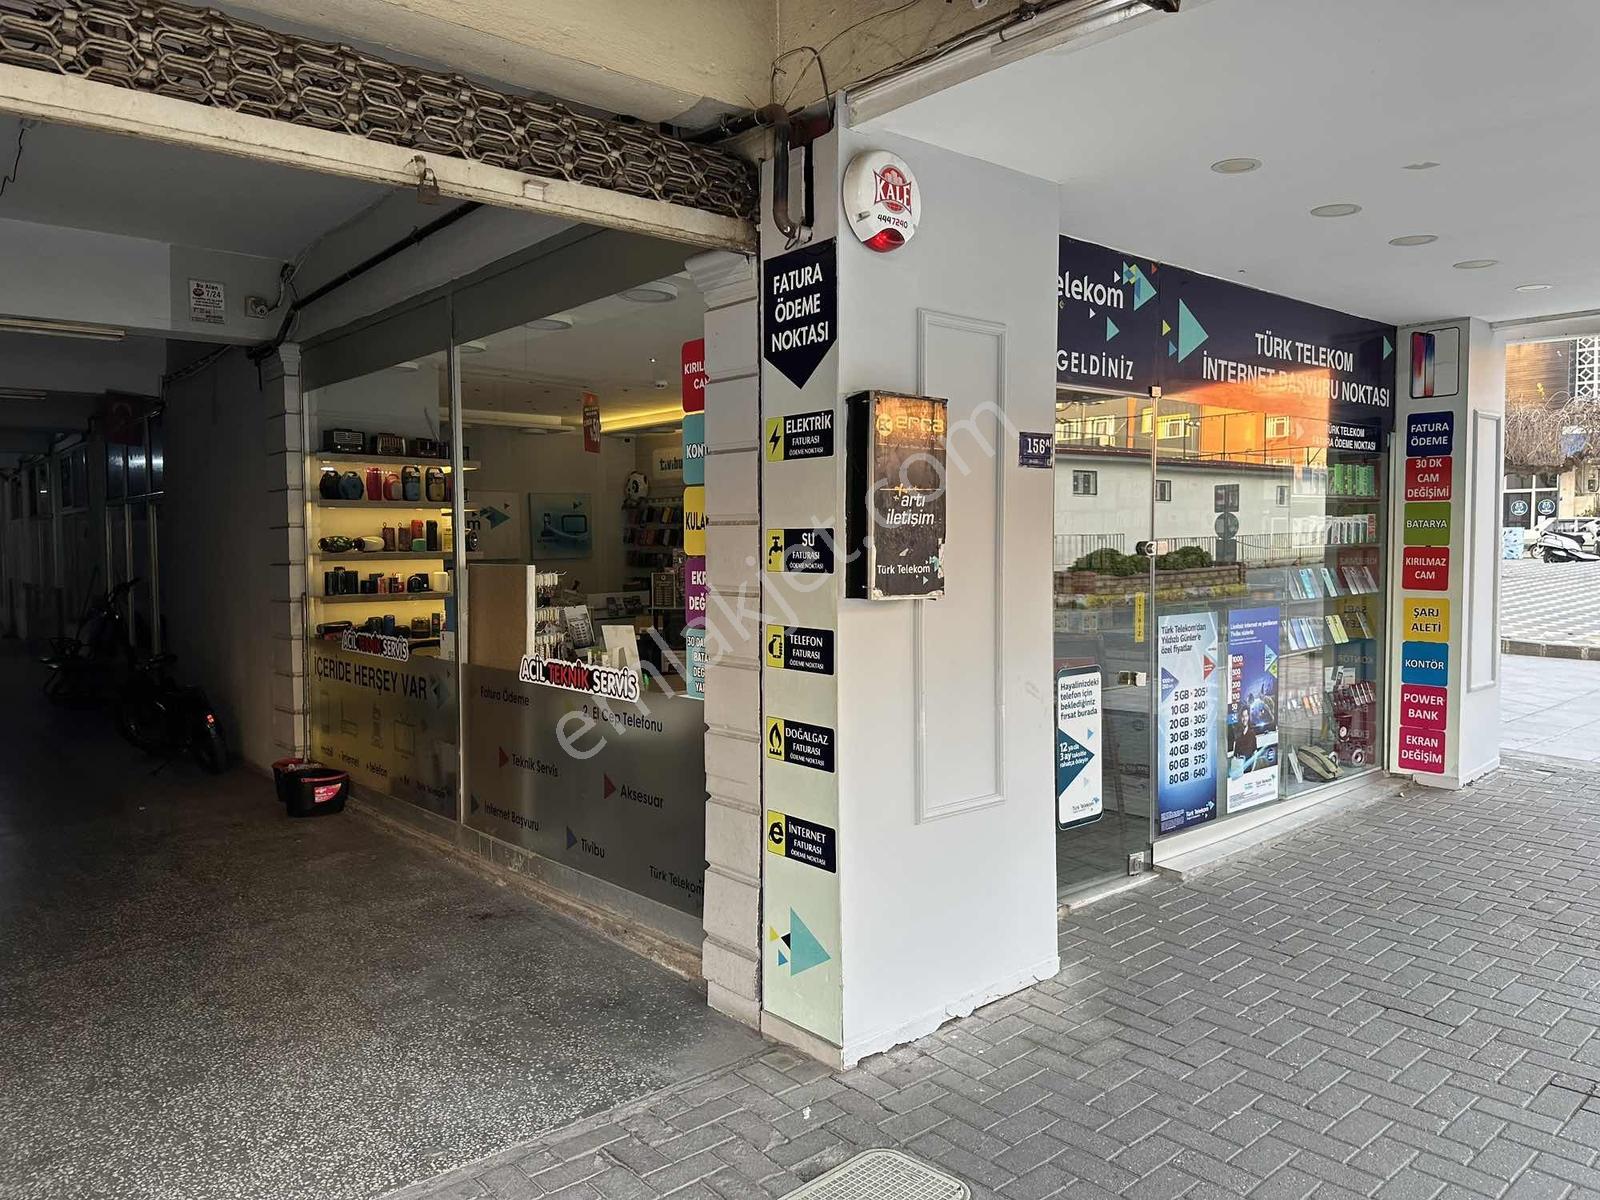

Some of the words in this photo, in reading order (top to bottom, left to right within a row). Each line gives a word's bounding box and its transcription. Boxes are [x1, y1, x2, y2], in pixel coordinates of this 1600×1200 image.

[875, 176, 911, 207] KALE
[877, 213, 908, 229] 4447240
[773, 263, 823, 295] FATURA
[774, 293, 821, 323] ÖDEME
[772, 321, 829, 352] NOKTASI
[1254, 330, 1292, 361] TÜRK
[1296, 341, 1354, 373] TELEKOM
[1056, 349, 1134, 381] GELDİNİZ
[1202, 350, 1276, 389] İNTERNET
[1341, 382, 1390, 408] NOKTASI
[786, 412, 832, 434] ELEKTRİK
[1410, 422, 1449, 434] FATURA
[1340, 425, 1365, 438] TELEKOM
[792, 435, 820, 447] FATURASI
[1334, 436, 1354, 448] ÖDEME
[1354, 440, 1377, 451] NOKTASI
[1410, 434, 1449, 447] ÖDEME
[1415, 459, 1428, 469] 30
[1429, 458, 1442, 468] DK
[1417, 473, 1440, 483] CAM
[1407, 485, 1449, 499] DEĞİŞİMİ
[901, 493, 926, 507] artı
[886, 508, 935, 527] iletişim
[1406, 520, 1447, 529] BATARYA
[801, 532, 815, 546] SU
[792, 551, 820, 560] FATURASI
[1405, 556, 1447, 567] KIRILMAZ
[877, 564, 896, 575] Türk
[897, 563, 931, 575] Telekom
[1414, 570, 1435, 580] CAM
[1413, 607, 1440, 619] ŞARJ
[1161, 626, 1173, 635] Türk
[1175, 624, 1207, 634] Telekom'dan
[1411, 622, 1441, 633] ALETİ
[342, 629, 357, 649] ACİL
[382, 636, 409, 660] SERVİS
[790, 634, 823, 647] TELEFON
[792, 648, 821, 660] FATURASI
[1161, 645, 1173, 655] özel
[1405, 658, 1445, 670] KONTÖR
[314, 652, 352, 682] İÇERİDE
[354, 663, 398, 696] HERŞEY
[401, 674, 428, 700] VAR
[521, 656, 546, 682] ACİL
[547, 659, 590, 690] TEKNİK
[592, 667, 638, 699] SERVİS
[1060, 678, 1099, 691] Hayalinizdeki
[480, 686, 500, 700] Fatura
[502, 688, 530, 706] Ödeme
[1060, 691, 1081, 701] telefon
[1174, 691, 1179, 701] 5
[1179, 690, 1189, 700] GB
[1194, 687, 1206, 698] 205
[1403, 693, 1444, 707] POWER
[1077, 707, 1098, 717] burada
[1171, 705, 1178, 715] 10
[1179, 703, 1189, 713] GB
[1193, 701, 1206, 711] 240
[1408, 708, 1438, 721] BANK
[592, 708, 600, 721] El
[623, 712, 663, 733] Telefonu
[1169, 718, 1178, 729] 20
[1179, 717, 1189, 727] GB
[1194, 714, 1206, 725] 305
[785, 728, 829, 745] DOĞALGAZ
[1170, 732, 1178, 743] 30
[1179, 731, 1189, 741] GB
[1194, 728, 1206, 738] 395
[1406, 735, 1438, 748] EKRAN
[792, 743, 821, 756] FATURASI
[1060, 742, 1068, 752] 12
[1169, 746, 1178, 757] 40
[1179, 744, 1189, 754] GB
[1193, 741, 1206, 752] 490
[1060, 753, 1064, 761] 3
[1169, 760, 1178, 771] 60
[1179, 758, 1189, 768] GB
[1194, 754, 1206, 765] 575
[1401, 748, 1442, 764] DEĞİŞİM
[512, 754, 535, 771] Teknik
[537, 760, 560, 778] Servis
[1169, 774, 1178, 784] 80
[1179, 771, 1189, 782] GB
[1193, 767, 1206, 779] 640
[620, 784, 664, 809] Aksesuar
[511, 812, 540, 832] Başvuru
[788, 821, 826, 844] İNTERNET
[581, 838, 605, 858] Tivibu
[793, 839, 822, 855] FATURASI
[649, 865, 667, 882] Türk
